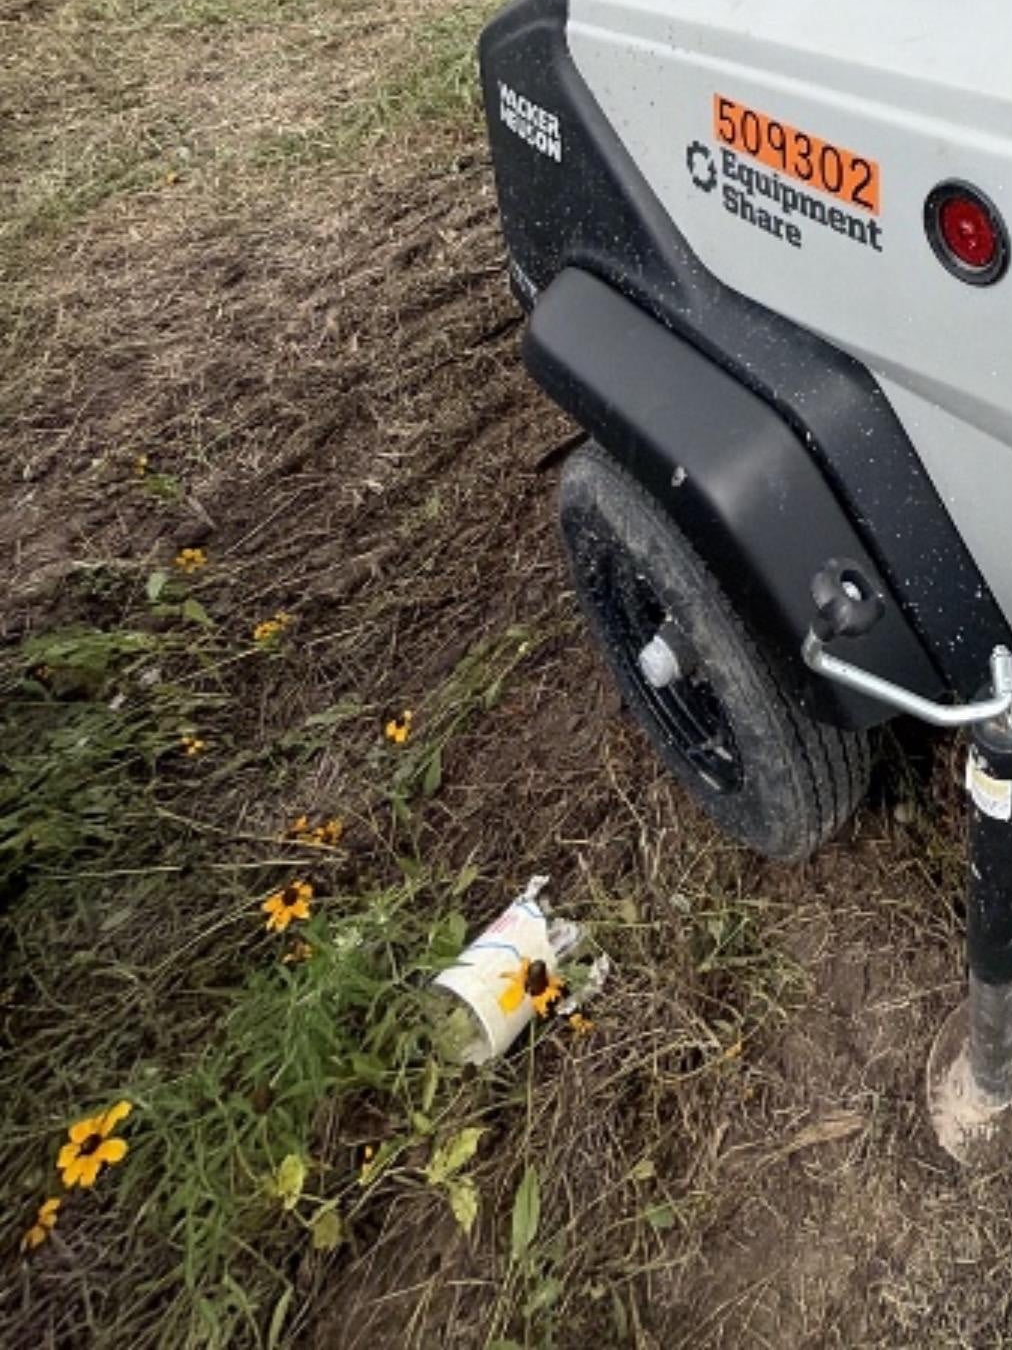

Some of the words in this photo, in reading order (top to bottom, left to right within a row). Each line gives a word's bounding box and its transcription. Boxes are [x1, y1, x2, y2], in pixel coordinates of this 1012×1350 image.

[717, 98, 875, 210] 509302
[720, 147, 884, 253] Equipment
[722, 183, 802, 249] Share
